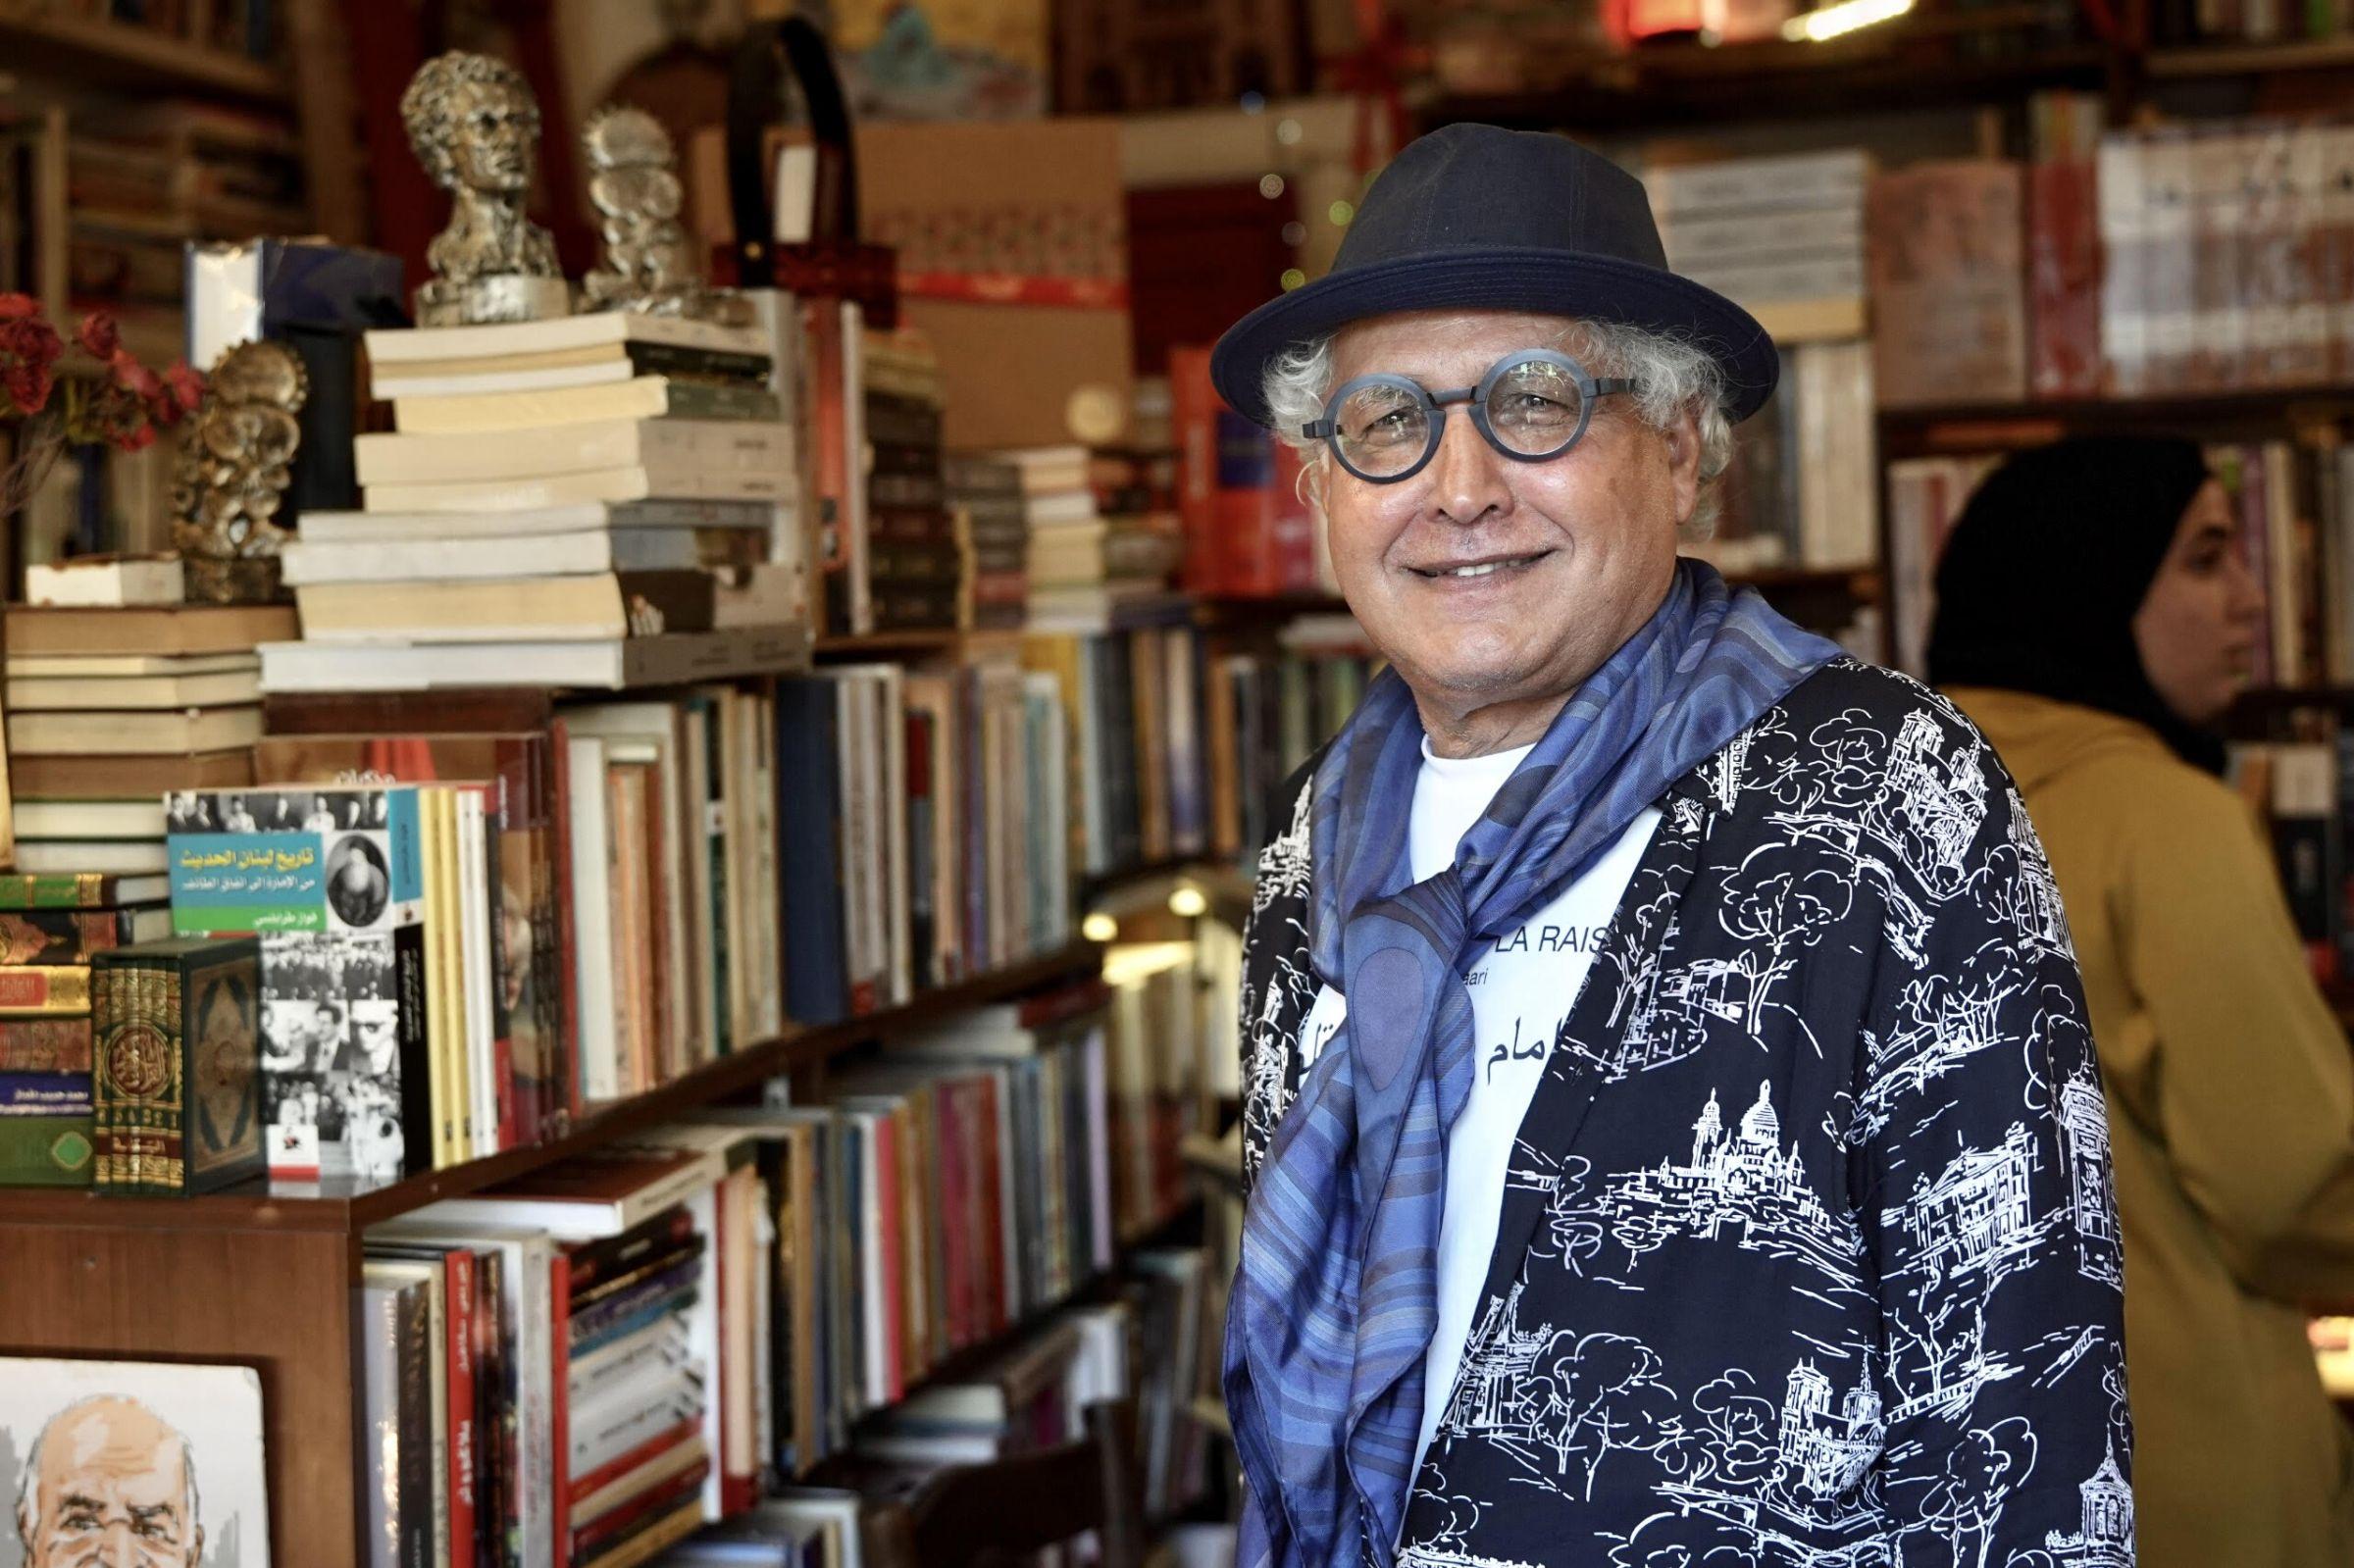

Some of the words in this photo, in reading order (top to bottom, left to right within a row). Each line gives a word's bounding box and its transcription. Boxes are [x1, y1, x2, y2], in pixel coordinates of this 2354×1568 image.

[180, 848, 236, 872] الحديث
[236, 848, 275, 872] لبنان
[276, 846, 315, 872] تاريخ
[1495, 926, 1528, 952] LA
